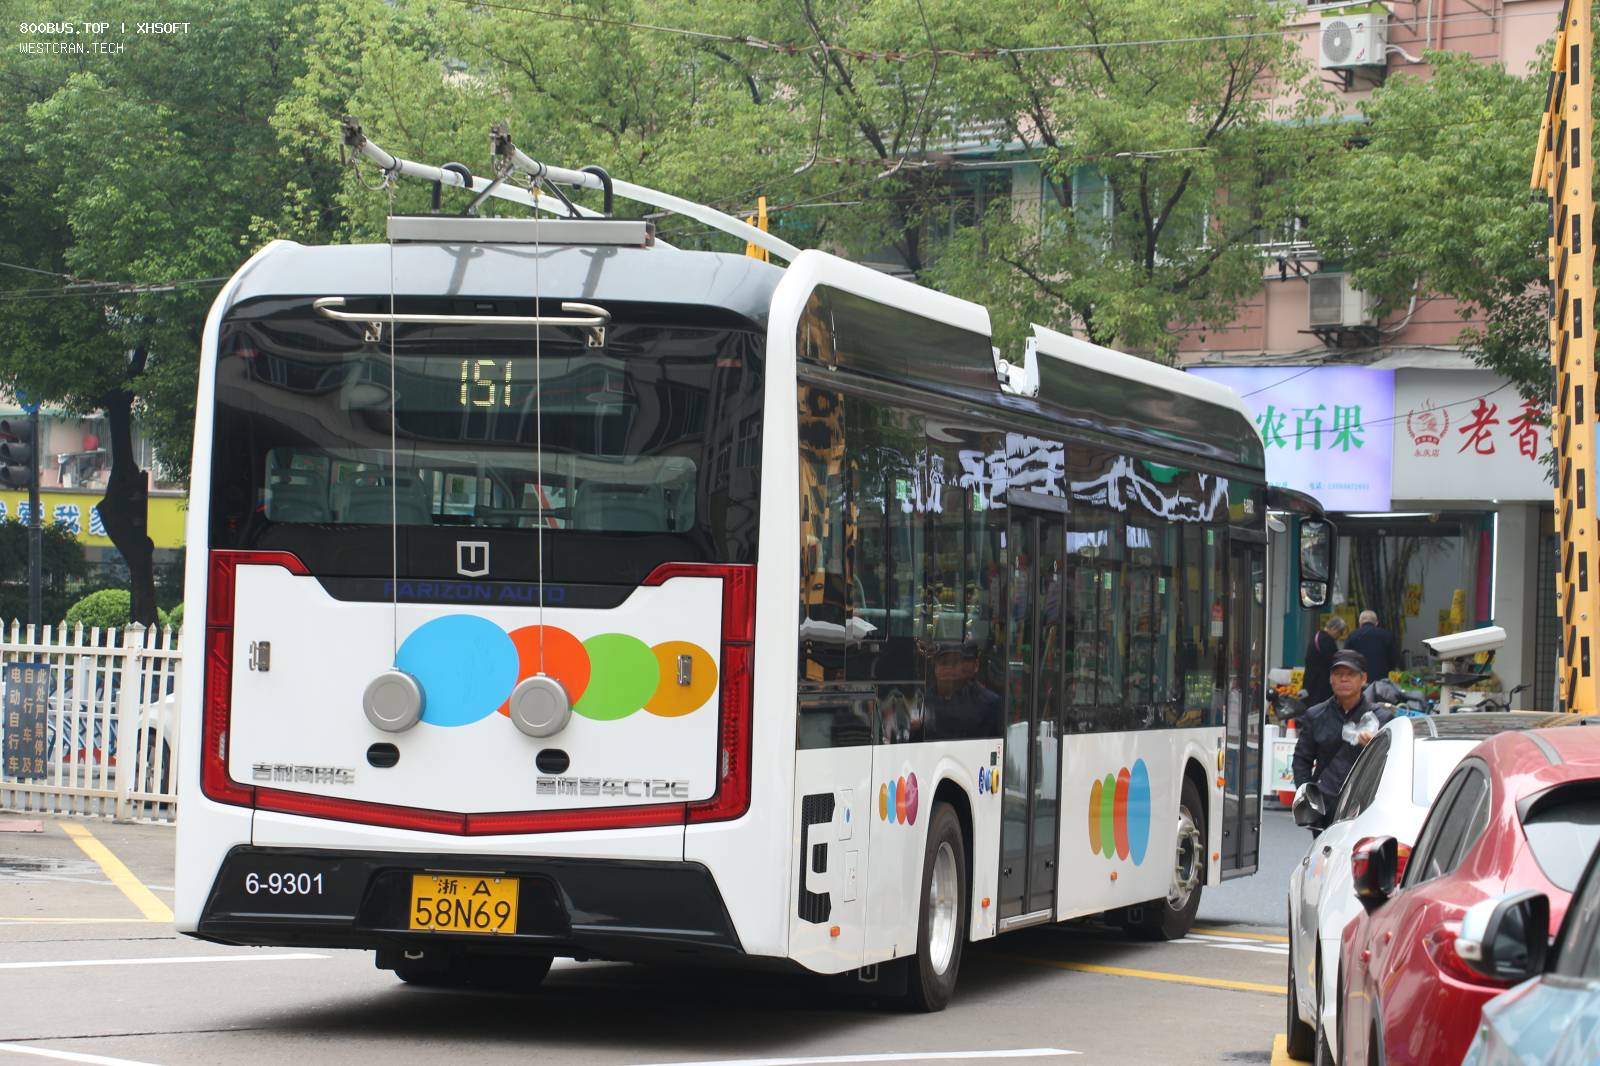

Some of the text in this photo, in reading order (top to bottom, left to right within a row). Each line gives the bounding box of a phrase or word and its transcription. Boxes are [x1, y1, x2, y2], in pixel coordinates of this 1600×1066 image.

[460, 360, 512, 407] 151
[1255, 404, 1366, 453] 农百果
[499, 585, 566, 603] AUTO
[8, 667, 21, 772] 电动自行车
[22, 668, 34, 773] 自行车及
[246, 872, 322, 895] 6-9301
[415, 897, 511, 929] 58N69
